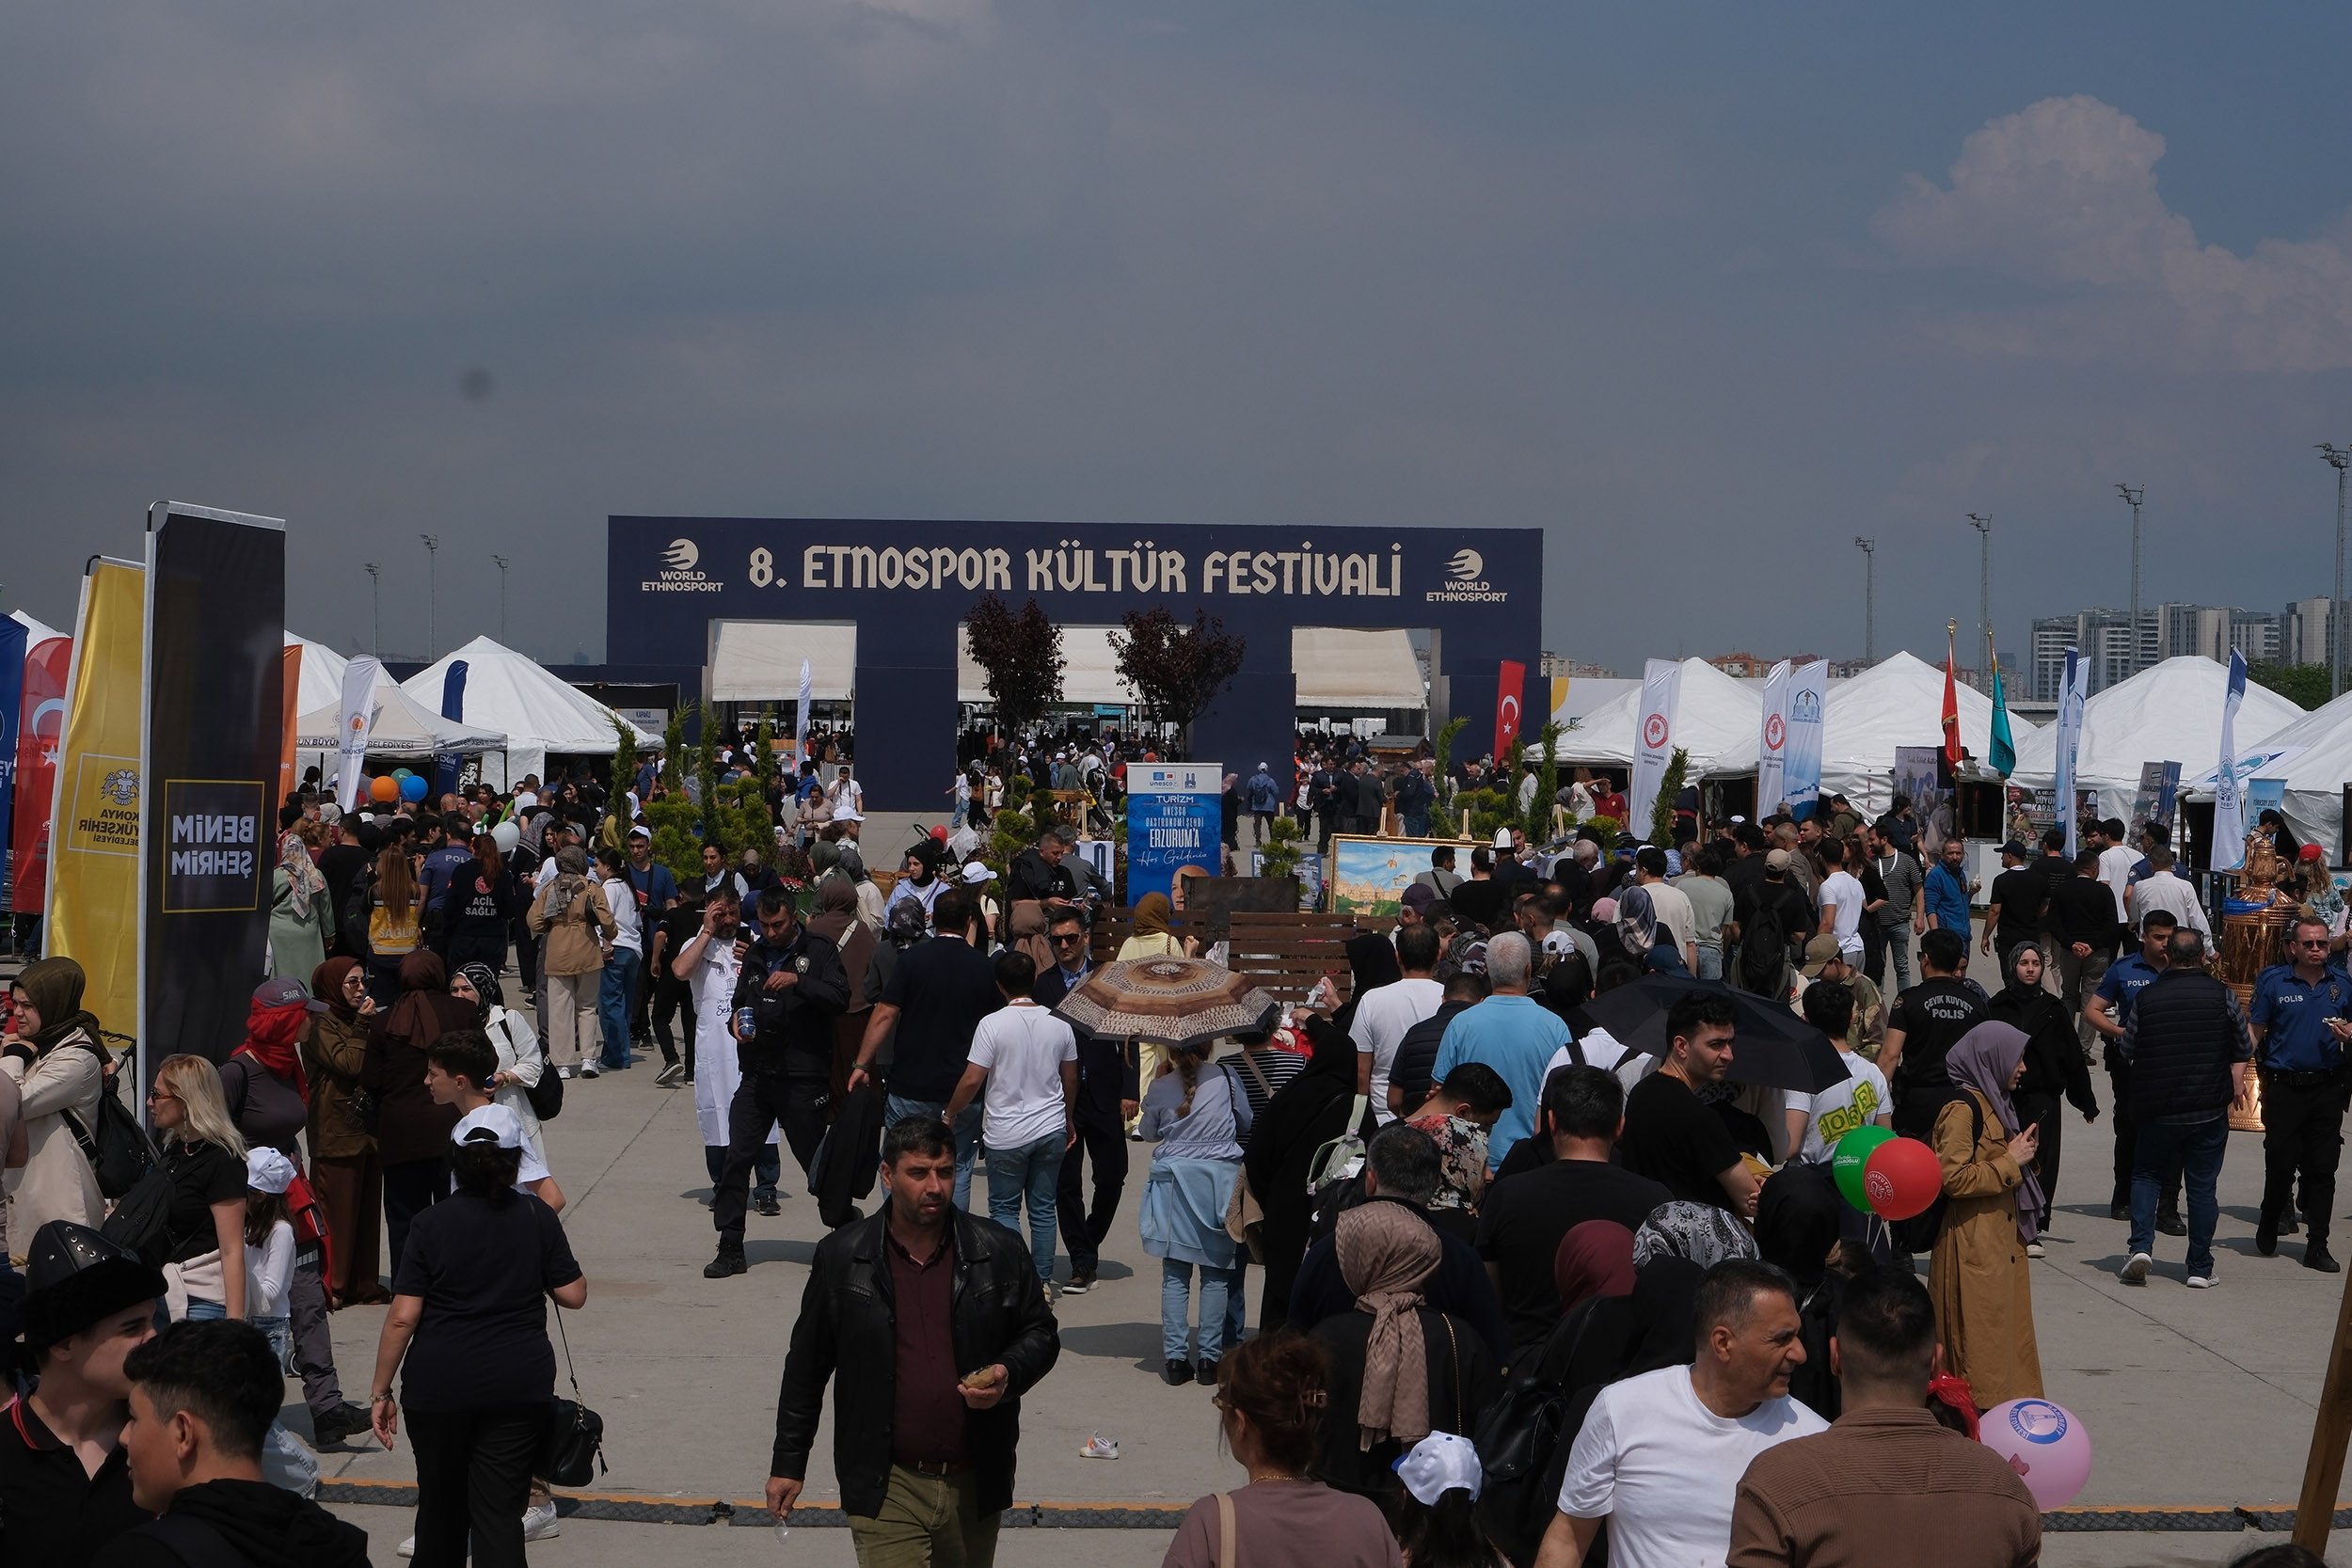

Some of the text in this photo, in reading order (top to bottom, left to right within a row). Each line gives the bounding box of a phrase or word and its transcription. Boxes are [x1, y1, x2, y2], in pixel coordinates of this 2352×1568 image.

[749, 539, 1401, 596] 8. ETNOSPOR KÜLTÜR FESTİVALİ
[660, 571, 706, 581] WORLD
[642, 581, 723, 592] ETHNOSPORT
[1444, 581, 1490, 592] WORLD
[1426, 592, 1507, 602] ETHNOSPORT
[368, 740, 414, 749] BELEDİYESİ
[1156, 795, 1194, 803] TURİZM
[2035, 795, 2055, 804] BÜYÜ
[1163, 806, 1186, 816] UNESCO
[1150, 828, 1200, 847] ERZURUM'A
[445, 854, 470, 863] POL
[472, 895, 495, 906] ACİL
[282, 990, 300, 1000] SAR
[1946, 995, 1974, 1014] KUVVET
